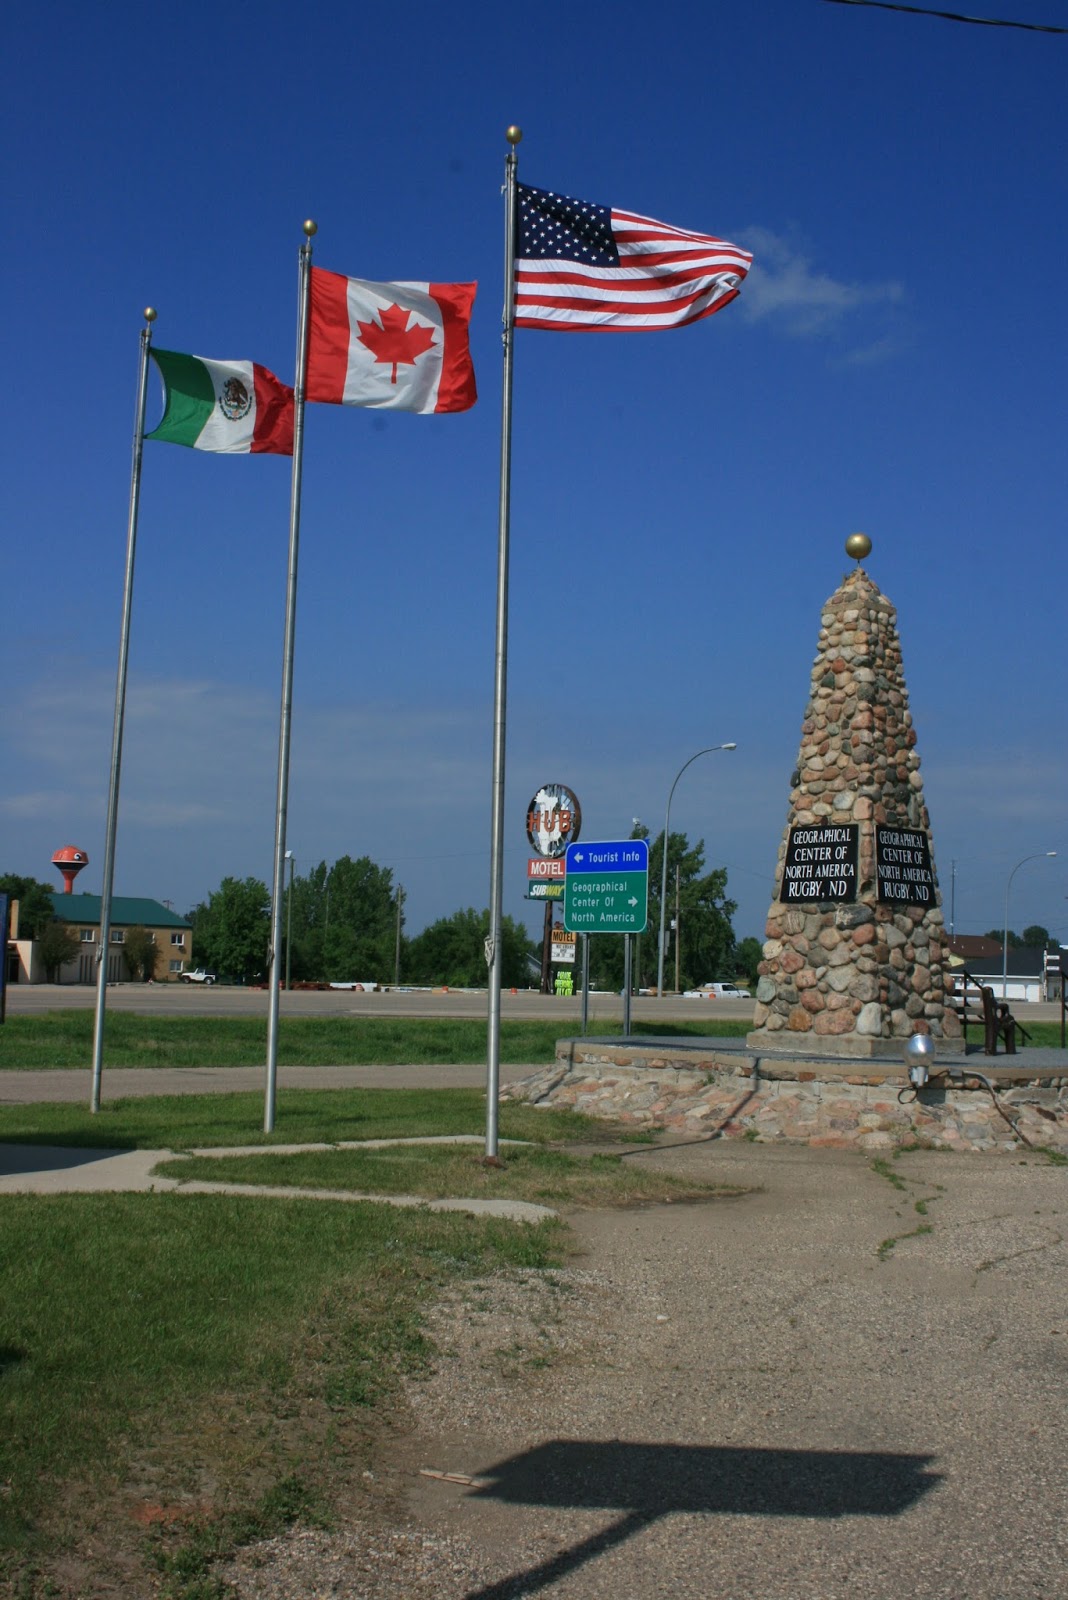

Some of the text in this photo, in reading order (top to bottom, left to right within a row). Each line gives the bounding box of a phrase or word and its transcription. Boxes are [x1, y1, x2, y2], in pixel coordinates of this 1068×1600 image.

[528, 810, 571, 832] HUB
[793, 829, 851, 845] GEOGRAPHICAL
[880, 831, 924, 848] GEOGRAPHICAL
[589, 851, 640, 863] Tourist Info
[794, 846, 848, 862] CENTER OF
[883, 848, 923, 865] CENTER OF
[531, 862, 563, 875] MOTEL
[785, 863, 855, 879] NORTH AMERICA
[877, 864, 932, 883] NORTH AMERICA
[530, 885, 564, 896] SUBWAY
[572, 882, 627, 894] Geographical
[788, 880, 847, 899] RUGBY, ND
[884, 882, 930, 901] RUGBY, ND
[572, 896, 614, 907] Center Of
[571, 912, 635, 922] North America
[553, 931, 574, 942] MOTEL
